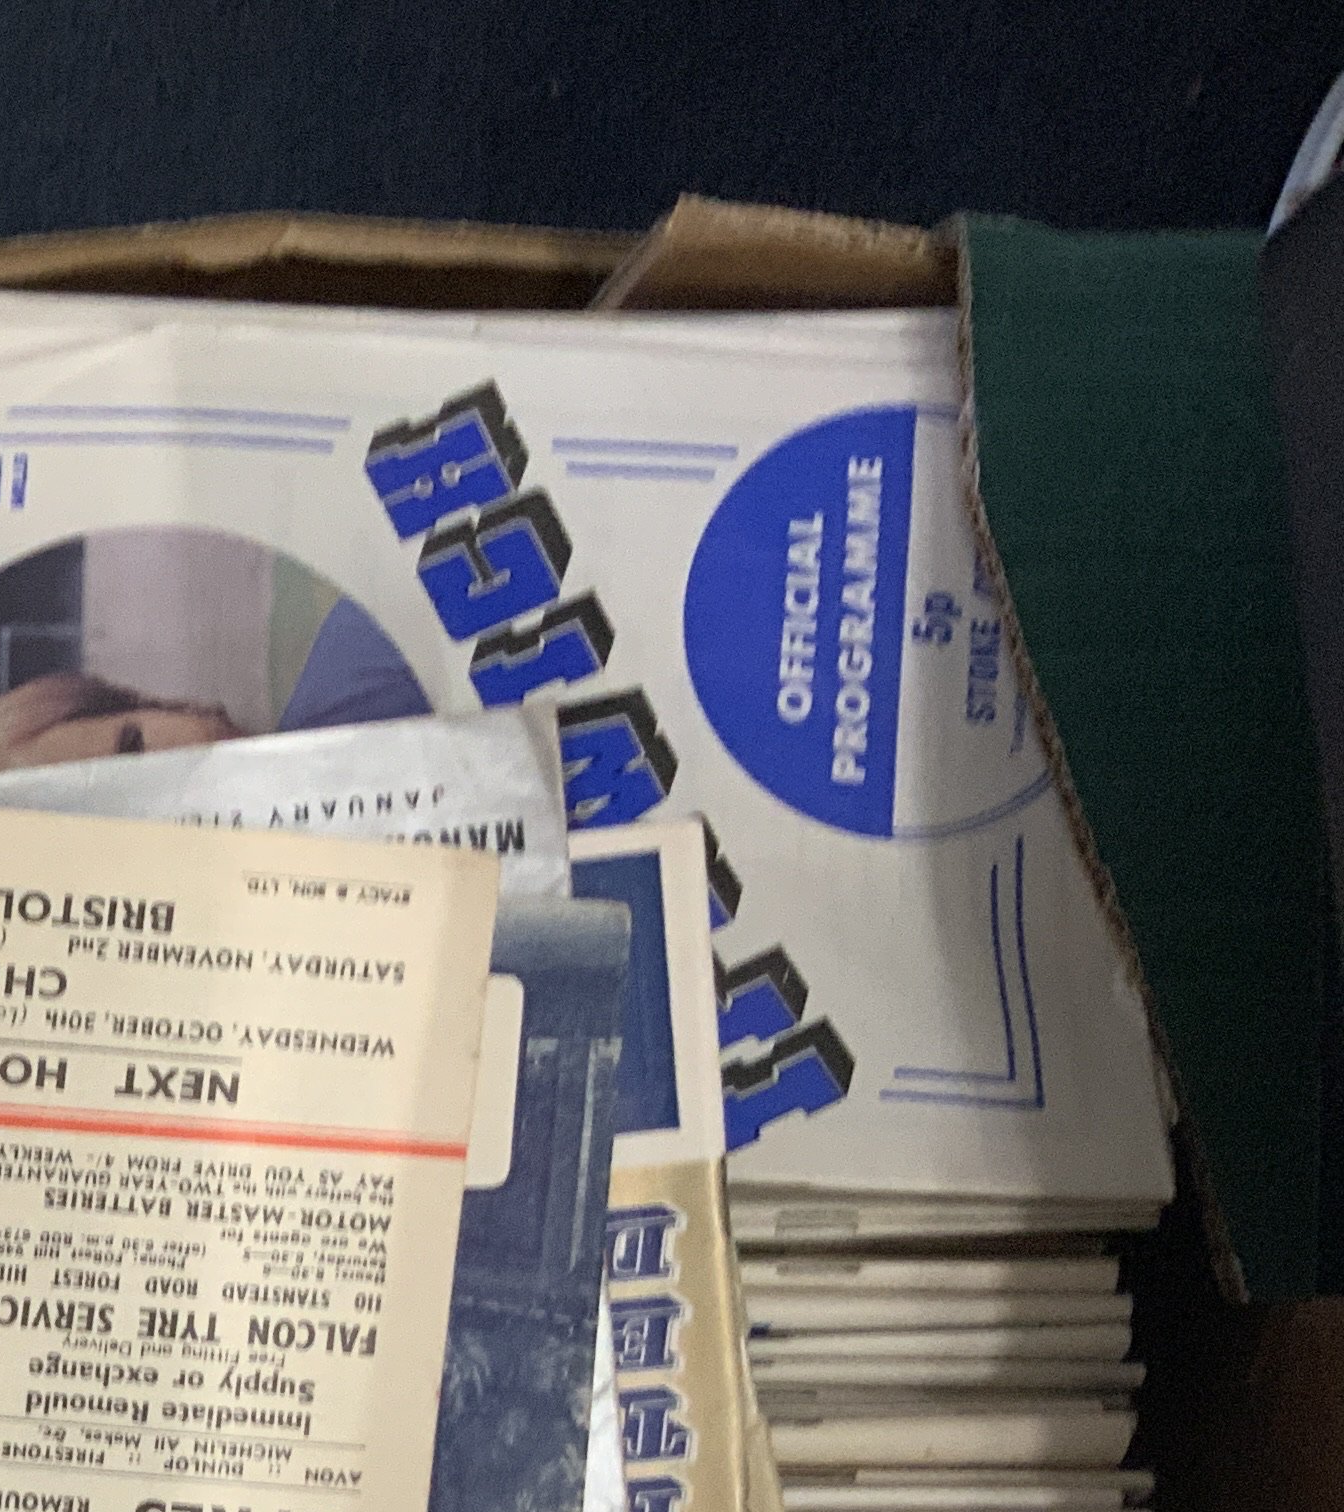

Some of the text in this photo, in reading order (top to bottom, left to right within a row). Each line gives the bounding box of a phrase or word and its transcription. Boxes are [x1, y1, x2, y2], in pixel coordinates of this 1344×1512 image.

[775, 510, 824, 723] OFFICIAL
[830, 455, 884, 786] PROGRAMME
[965, 615, 1002, 725] STOKE
[268, 782, 446, 830] JANUARY
[43, 1007, 396, 1059] WEDNESDAY, OCTOBER, 30th
[112, 1063, 241, 1106] NEXT
[135, 1305, 221, 1345] TYRE
[245, 1314, 378, 1358] FALCON
